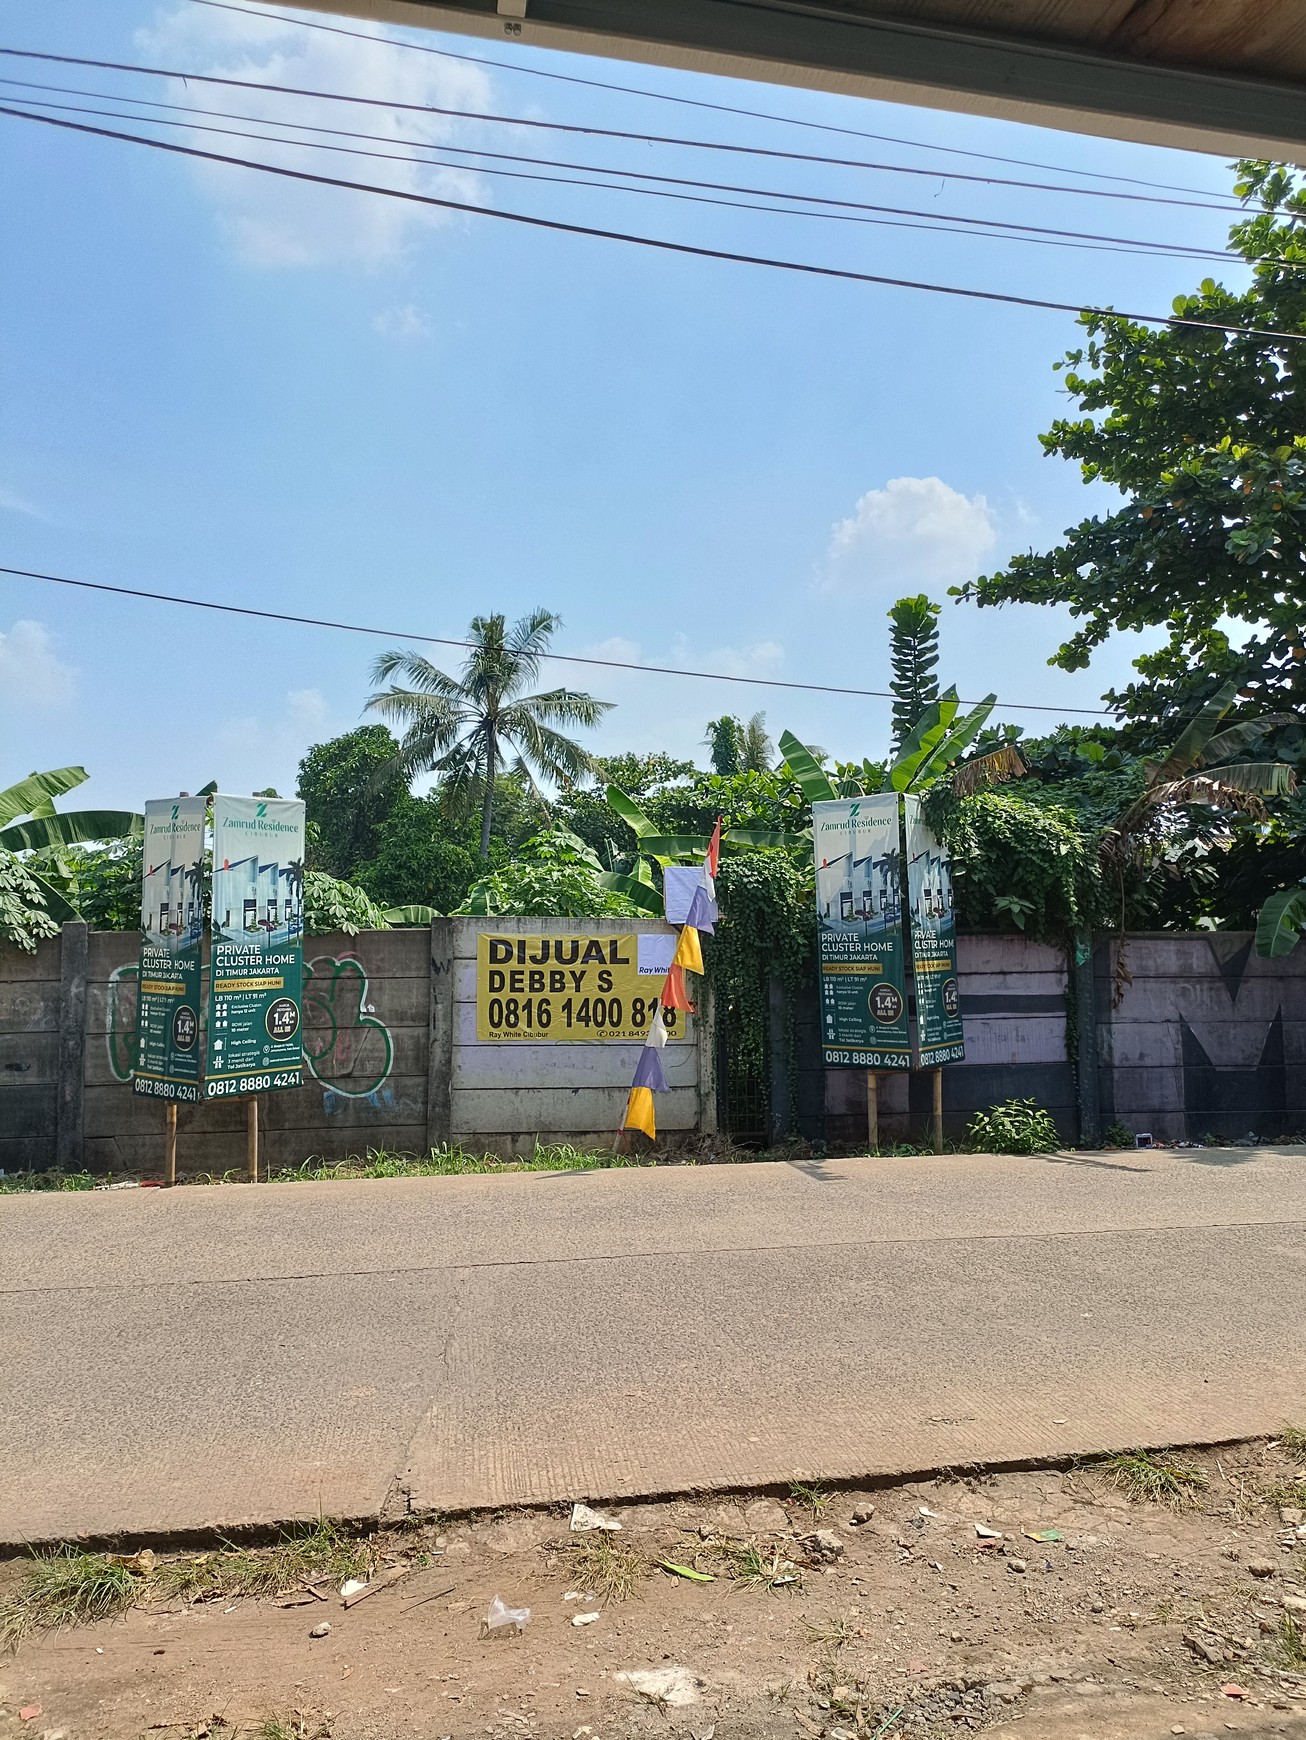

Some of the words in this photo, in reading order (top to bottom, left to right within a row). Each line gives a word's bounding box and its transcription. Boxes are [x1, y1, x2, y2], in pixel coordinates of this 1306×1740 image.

[150, 823, 171, 834] Zamrud
[171, 822, 201, 832] Residence
[222, 817, 256, 829] Zamrud
[258, 820, 298, 832] Residence
[820, 820, 850, 832] Zamrud
[852, 816, 892, 828] Residence
[822, 932, 859, 942] PRIVATE
[144, 948, 170, 958] PRIVATE
[216, 944, 260, 956] PRIVATE
[489, 940, 630, 964] DIJUAL
[822, 943, 862, 952] CLUSTER
[864, 942, 893, 951] HOME
[142, 958, 172, 970] CLUSTER
[174, 960, 195, 970] HOME
[216, 956, 262, 966] CLUSTER
[265, 954, 295, 965] HOME
[638, 966, 653, 974] Ray
[489, 970, 587, 992] DEBBY
[598, 970, 613, 993] S
[489, 998, 551, 1028] 0816
[562, 998, 622, 1028] 1400
[632, 998, 676, 1028] 818
[826, 1051, 850, 1063] 0812
[852, 1053, 880, 1065] 8880
[884, 1054, 910, 1067] 4241
[921, 1052, 934, 1066] 0812
[935, 1048, 950, 1062] 8880
[951, 1046, 964, 1058] 4241
[135, 1078, 152, 1094] 0812
[154, 1082, 174, 1098] 8880
[176, 1086, 196, 1100] 4241
[208, 1080, 236, 1096] 0812
[240, 1076, 270, 1091] 8880
[274, 1072, 300, 1086] 4241
